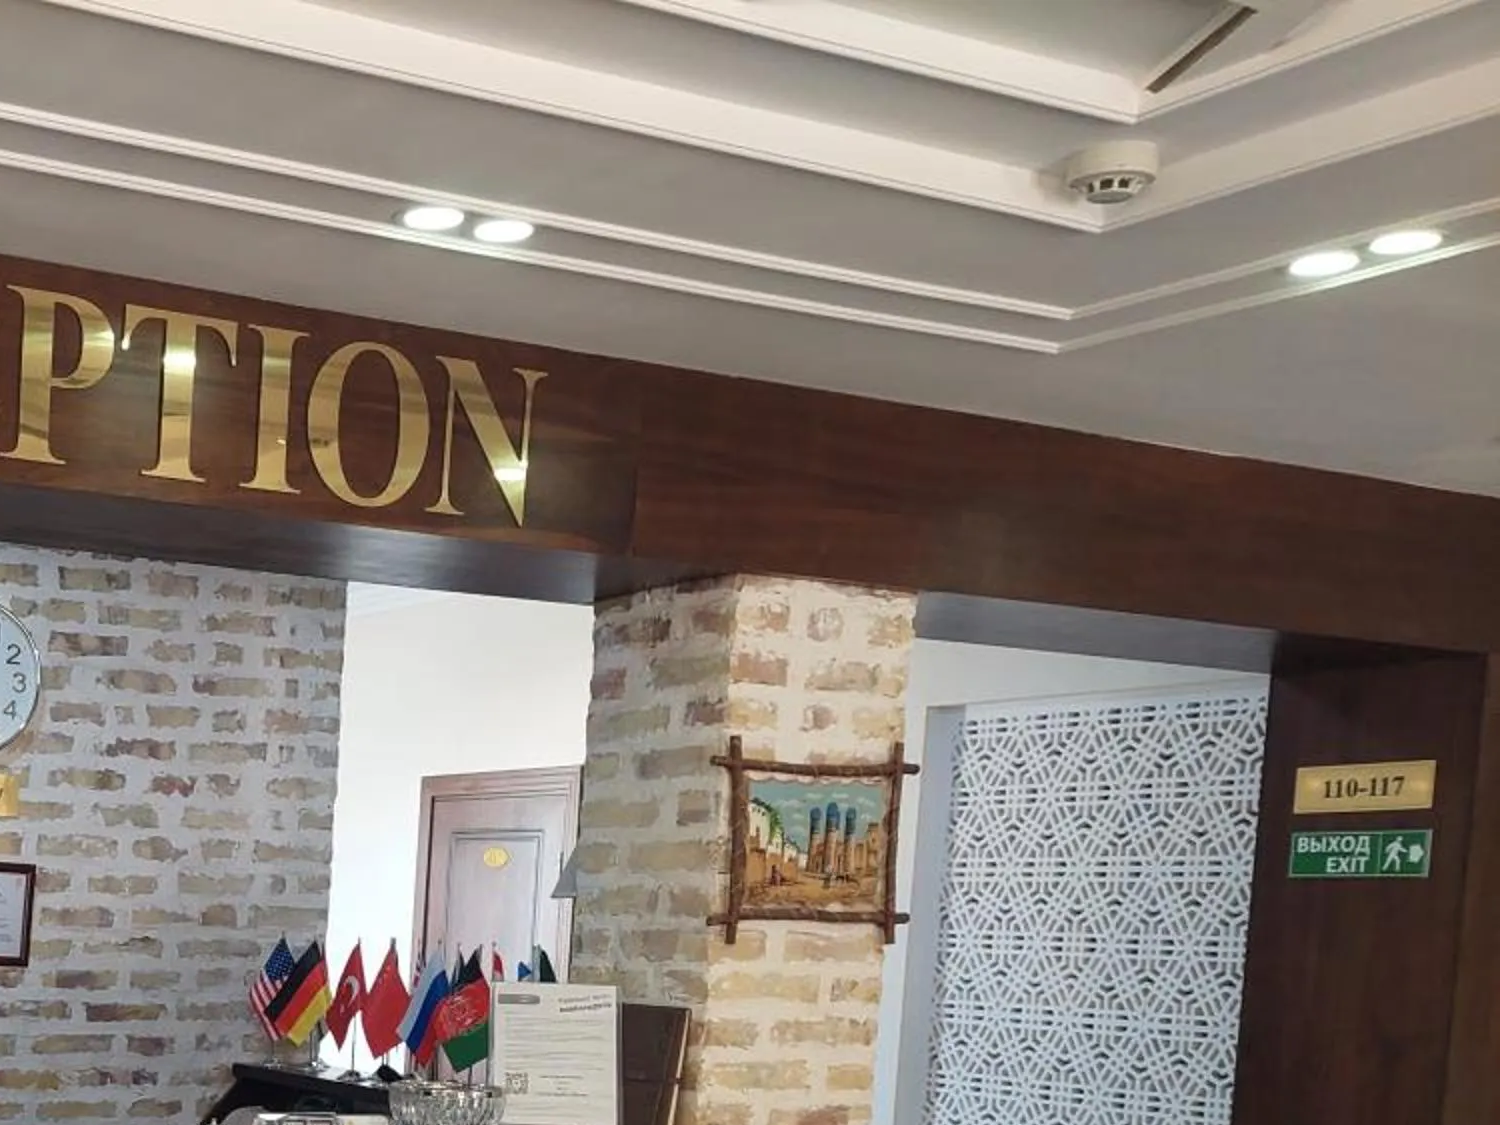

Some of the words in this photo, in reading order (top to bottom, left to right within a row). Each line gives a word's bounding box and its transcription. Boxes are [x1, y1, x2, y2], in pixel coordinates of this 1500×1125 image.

[6, 644, 21, 665] 2
[12, 672, 27, 693] 3
[3, 700, 17, 720] 4
[1324, 776, 1405, 798] 110-117
[1297, 835, 1371, 856] ВЫХОД
[1326, 856, 1369, 873] EXIT
